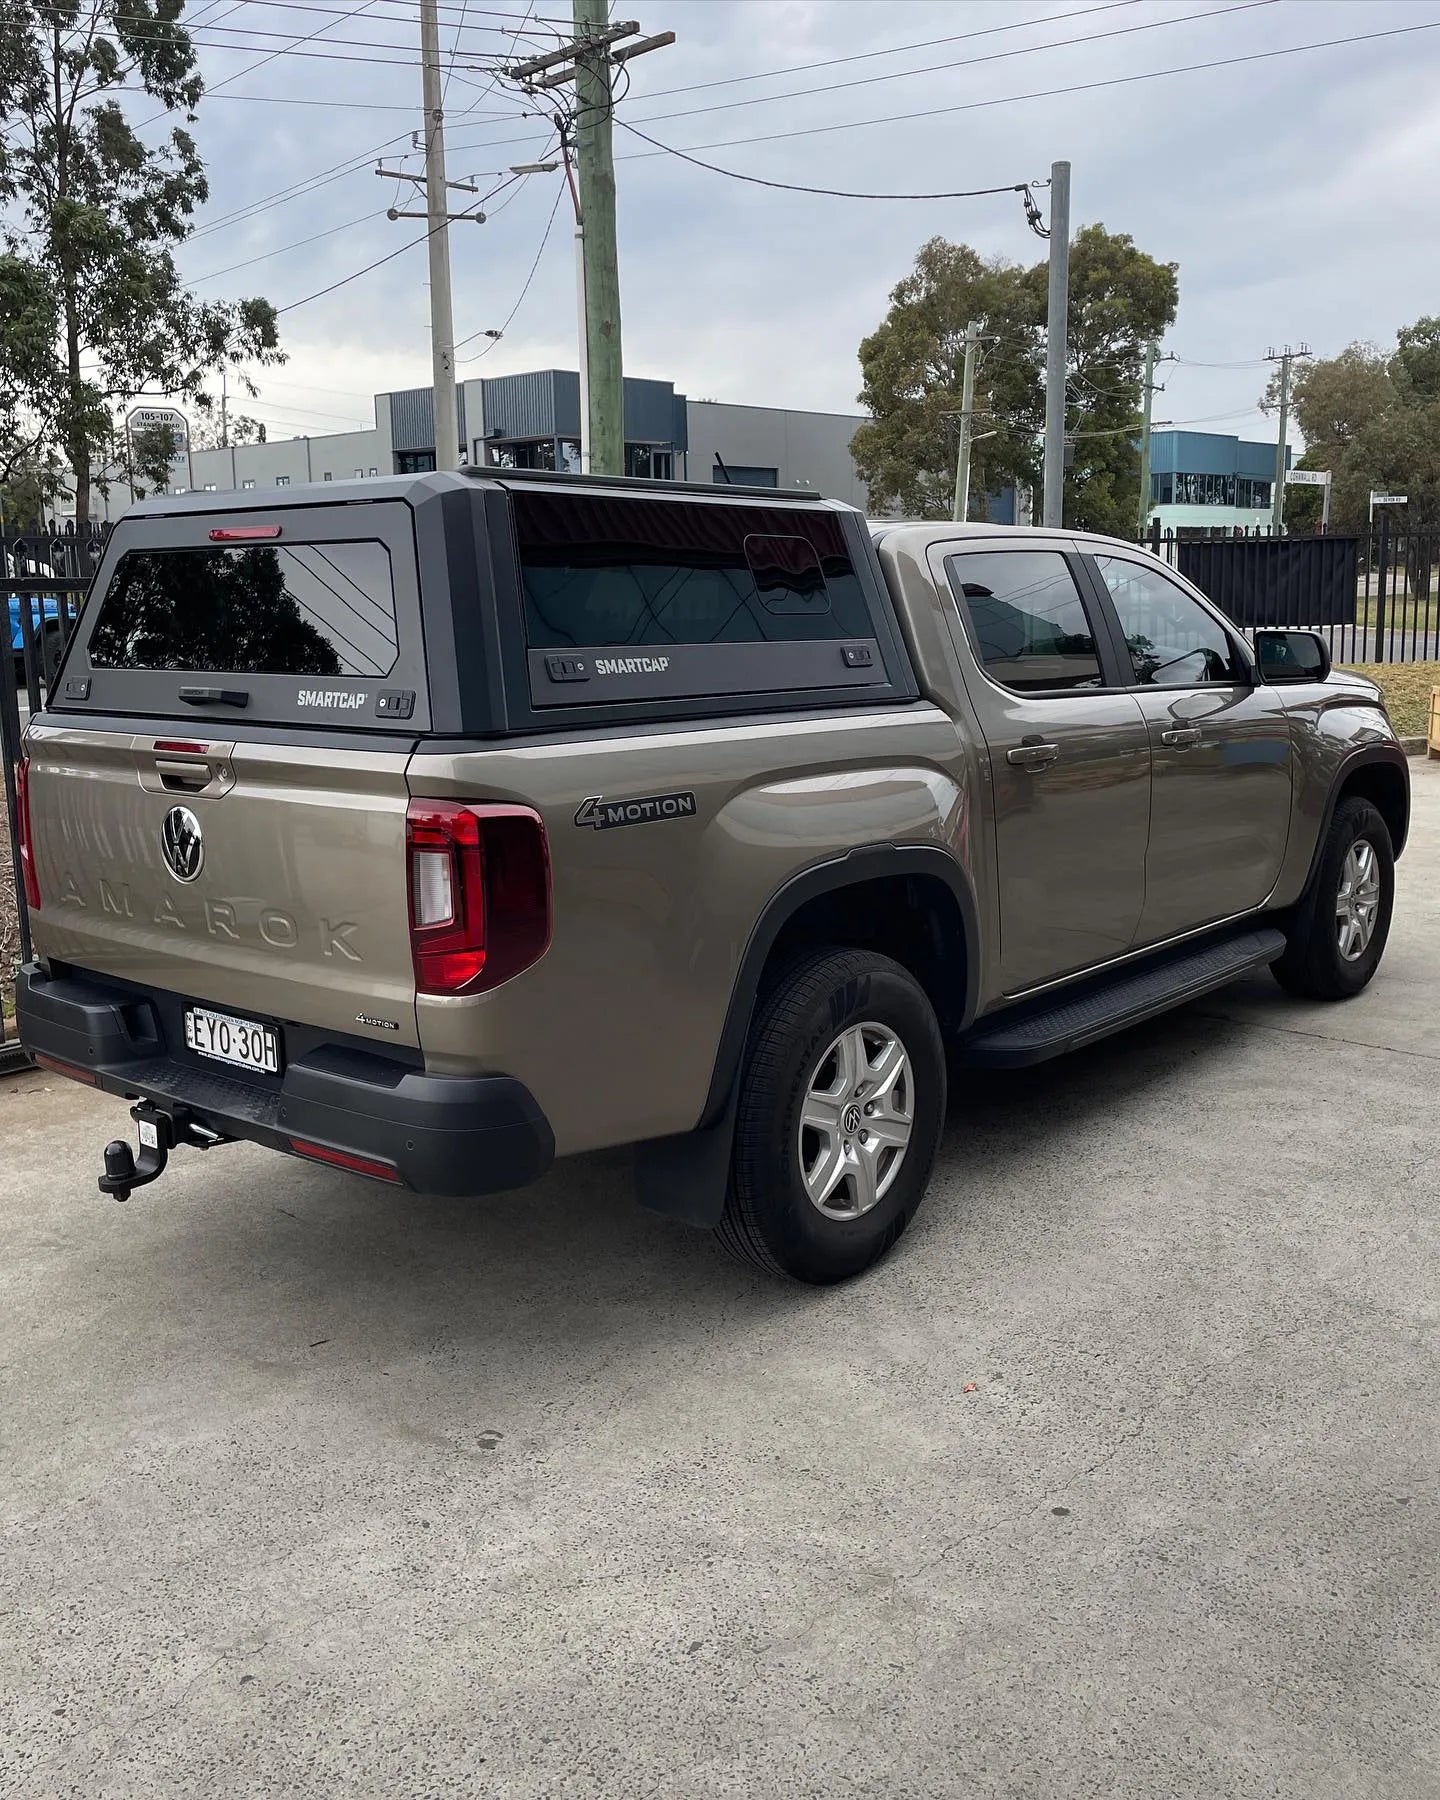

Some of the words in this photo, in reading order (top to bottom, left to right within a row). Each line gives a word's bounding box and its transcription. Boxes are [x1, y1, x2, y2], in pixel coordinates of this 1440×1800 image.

[141, 413, 173, 421] 105-107
[595, 657, 669, 675] SMARTCAP
[297, 690, 366, 709] SMARTCAP
[575, 797, 693, 827] 4MOTION
[61, 872, 362, 961] AMAROK
[355, 1012, 395, 1028] 4MOTION
